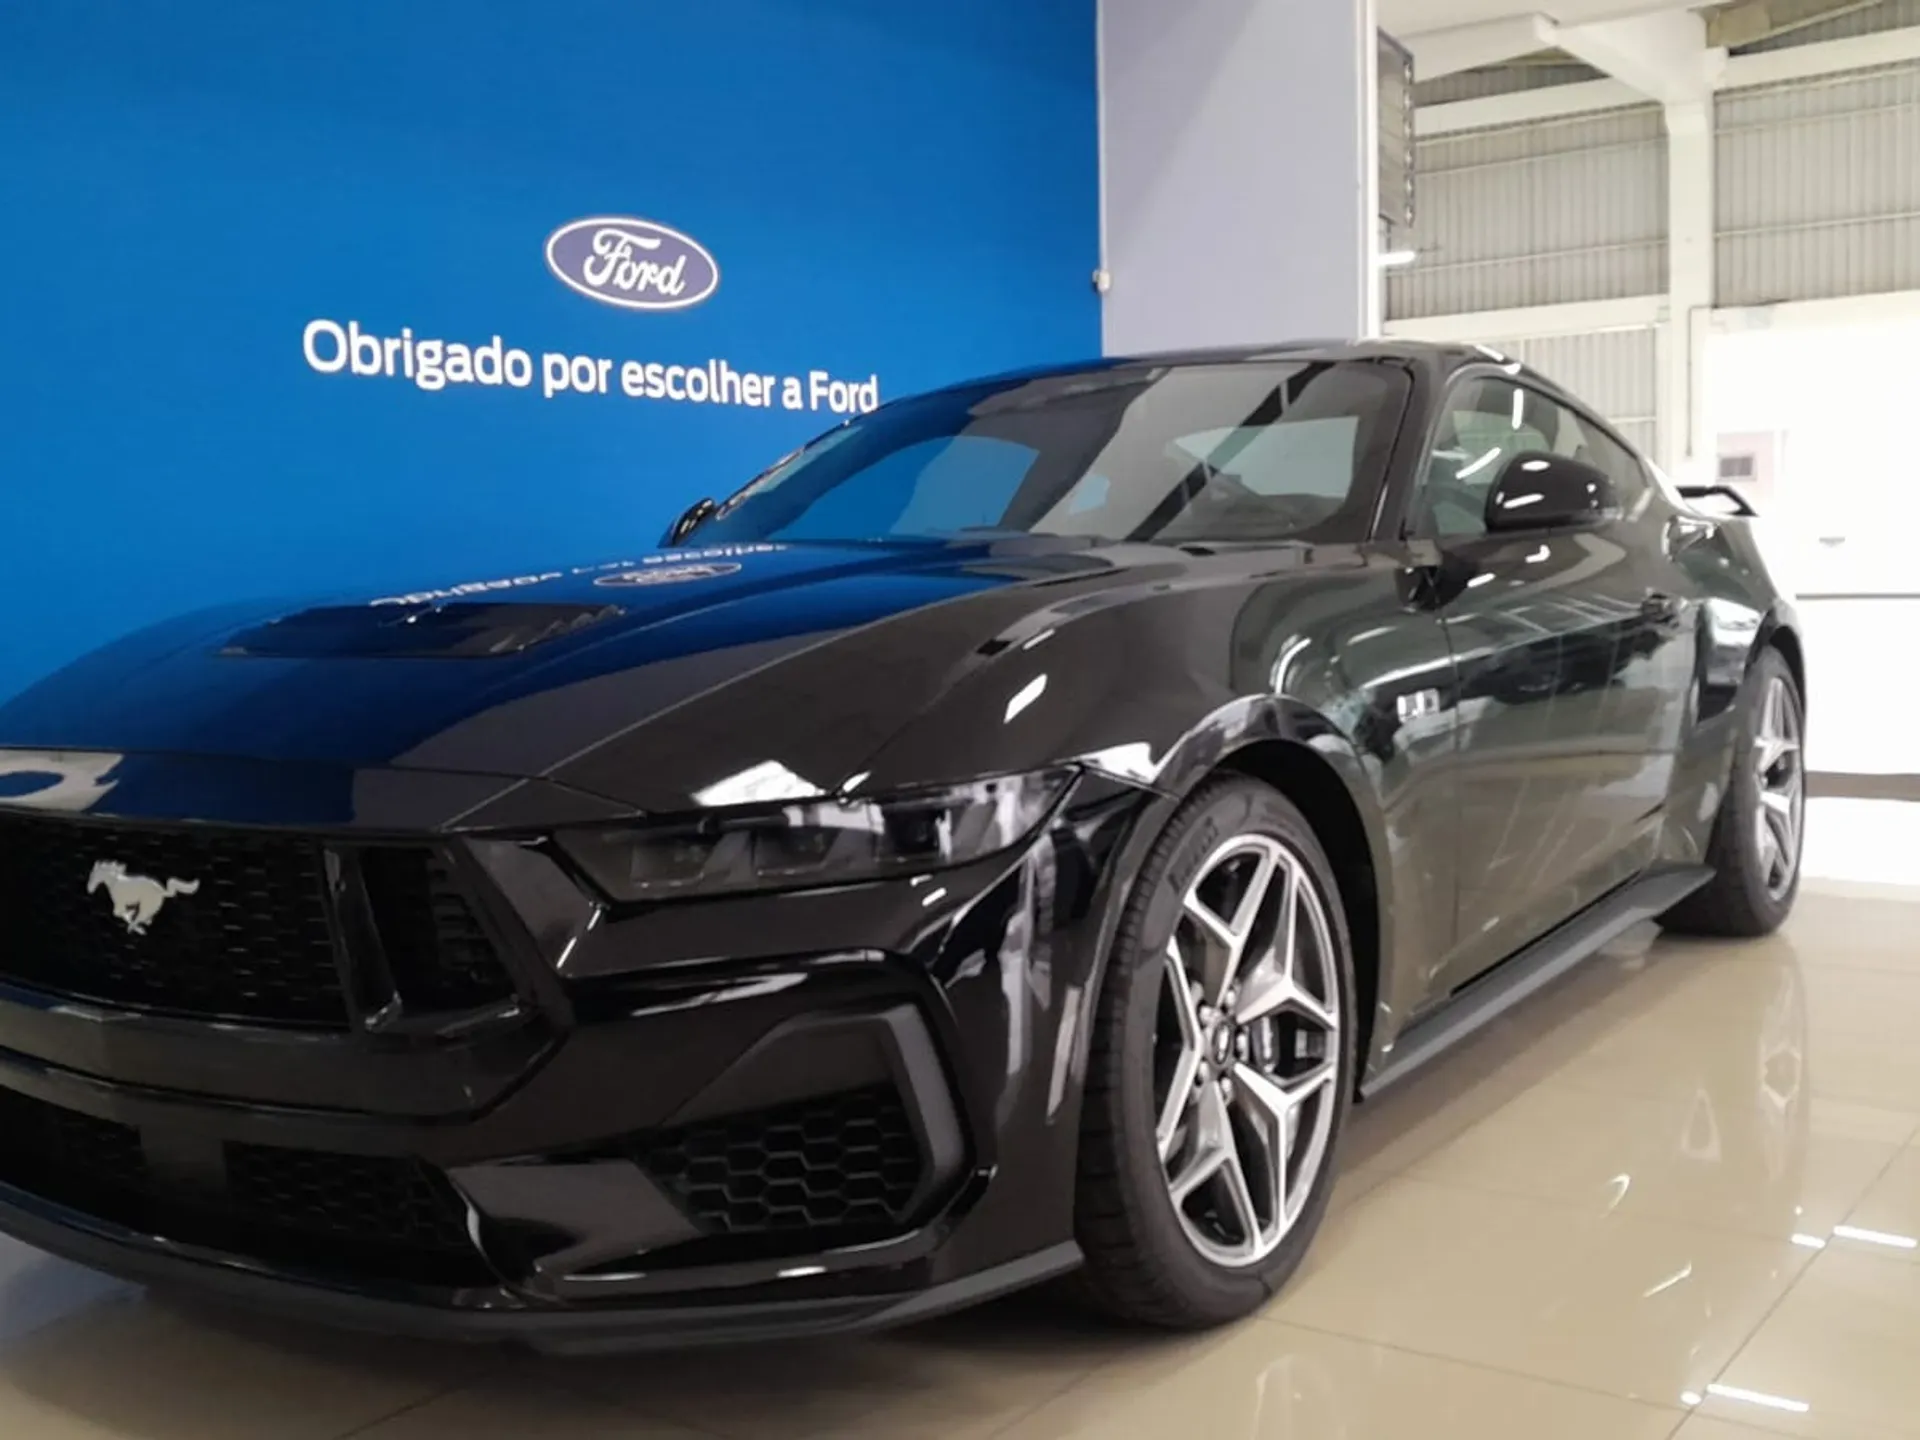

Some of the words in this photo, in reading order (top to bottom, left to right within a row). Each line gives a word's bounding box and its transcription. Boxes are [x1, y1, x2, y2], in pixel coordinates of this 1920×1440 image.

[583, 227, 687, 296] Ford
[303, 319, 532, 390] Obrigado
[542, 353, 612, 398] por
[621, 359, 775, 407] escolher
[781, 376, 804, 410] a
[809, 370, 878, 414] Ford
